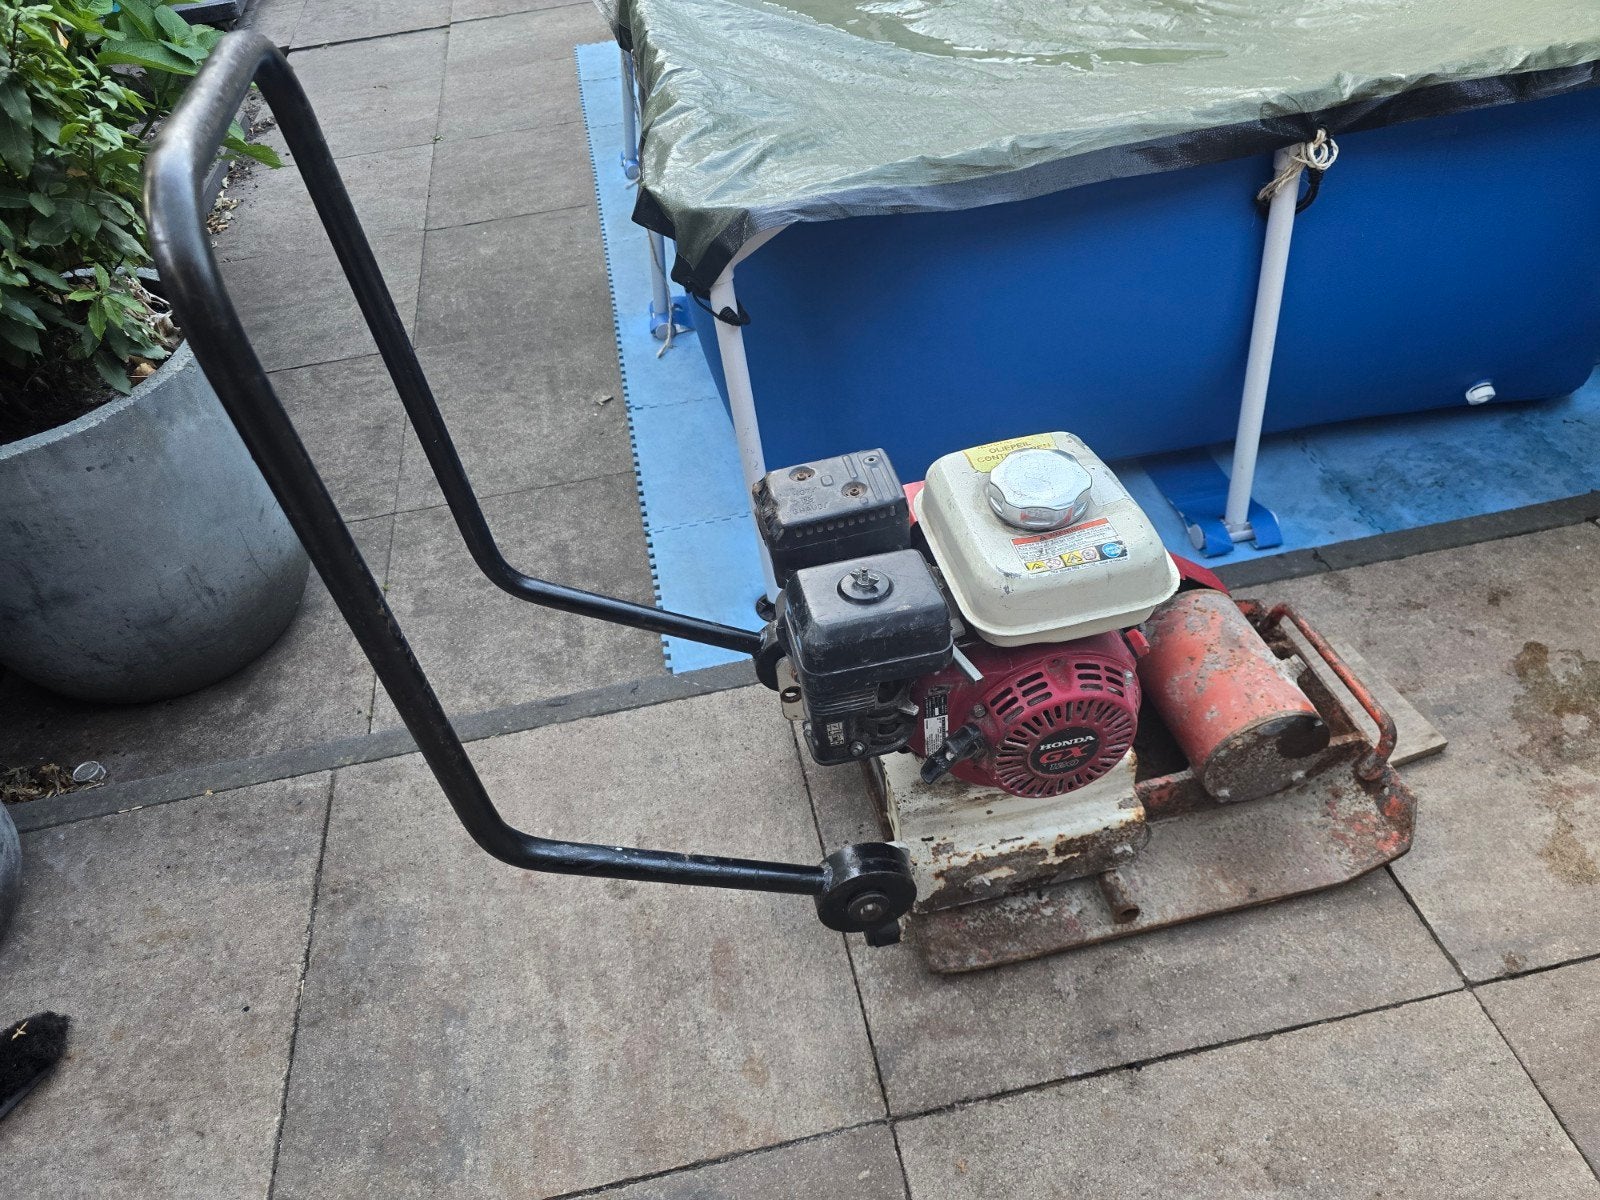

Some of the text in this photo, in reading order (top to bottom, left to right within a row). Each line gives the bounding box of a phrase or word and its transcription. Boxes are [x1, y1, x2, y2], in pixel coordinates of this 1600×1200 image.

[1048, 525, 1082, 539] WARNING
[1039, 735, 1096, 751] HONDA
[1040, 744, 1092, 763] GX
